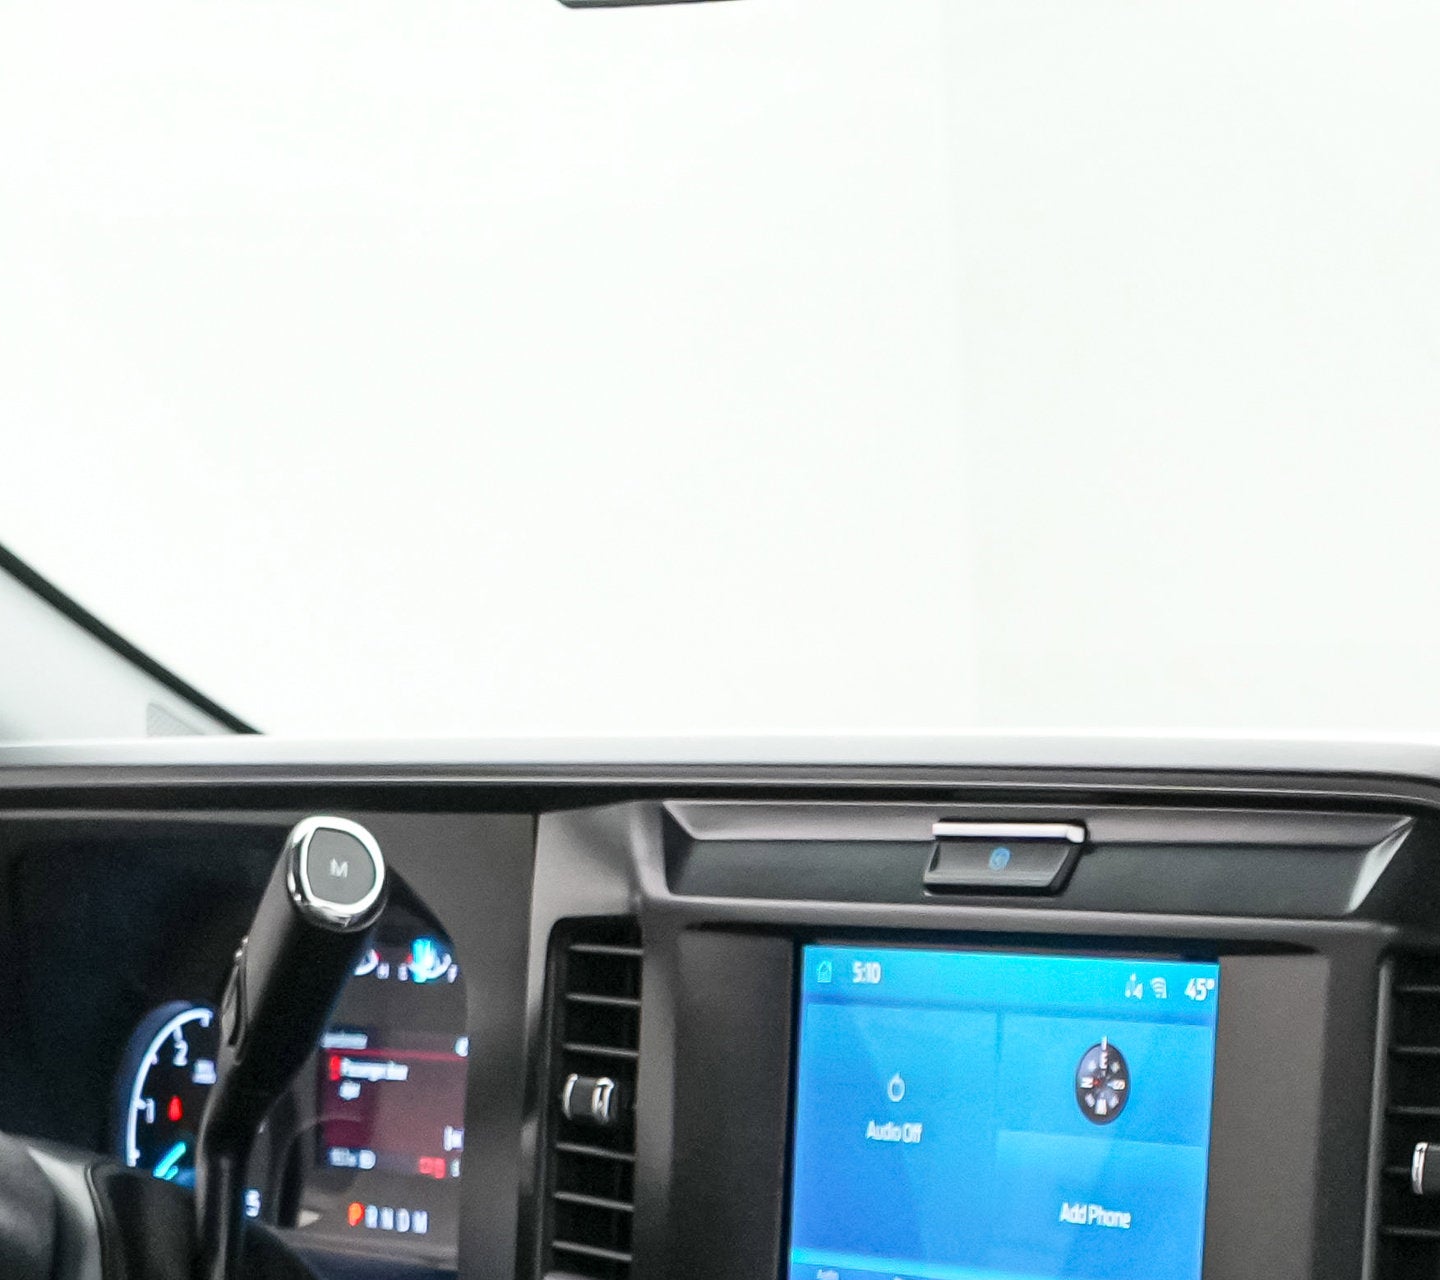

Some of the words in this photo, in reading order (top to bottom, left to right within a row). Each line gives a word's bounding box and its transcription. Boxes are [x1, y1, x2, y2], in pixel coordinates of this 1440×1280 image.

[330, 859, 348, 878] M
[851, 961, 882, 985] 5:10
[866, 1120, 902, 1142] Audio
[902, 1122, 923, 1144] Off
[1060, 1202, 1087, 1224] Add
[1088, 1203, 1131, 1229] Phone
